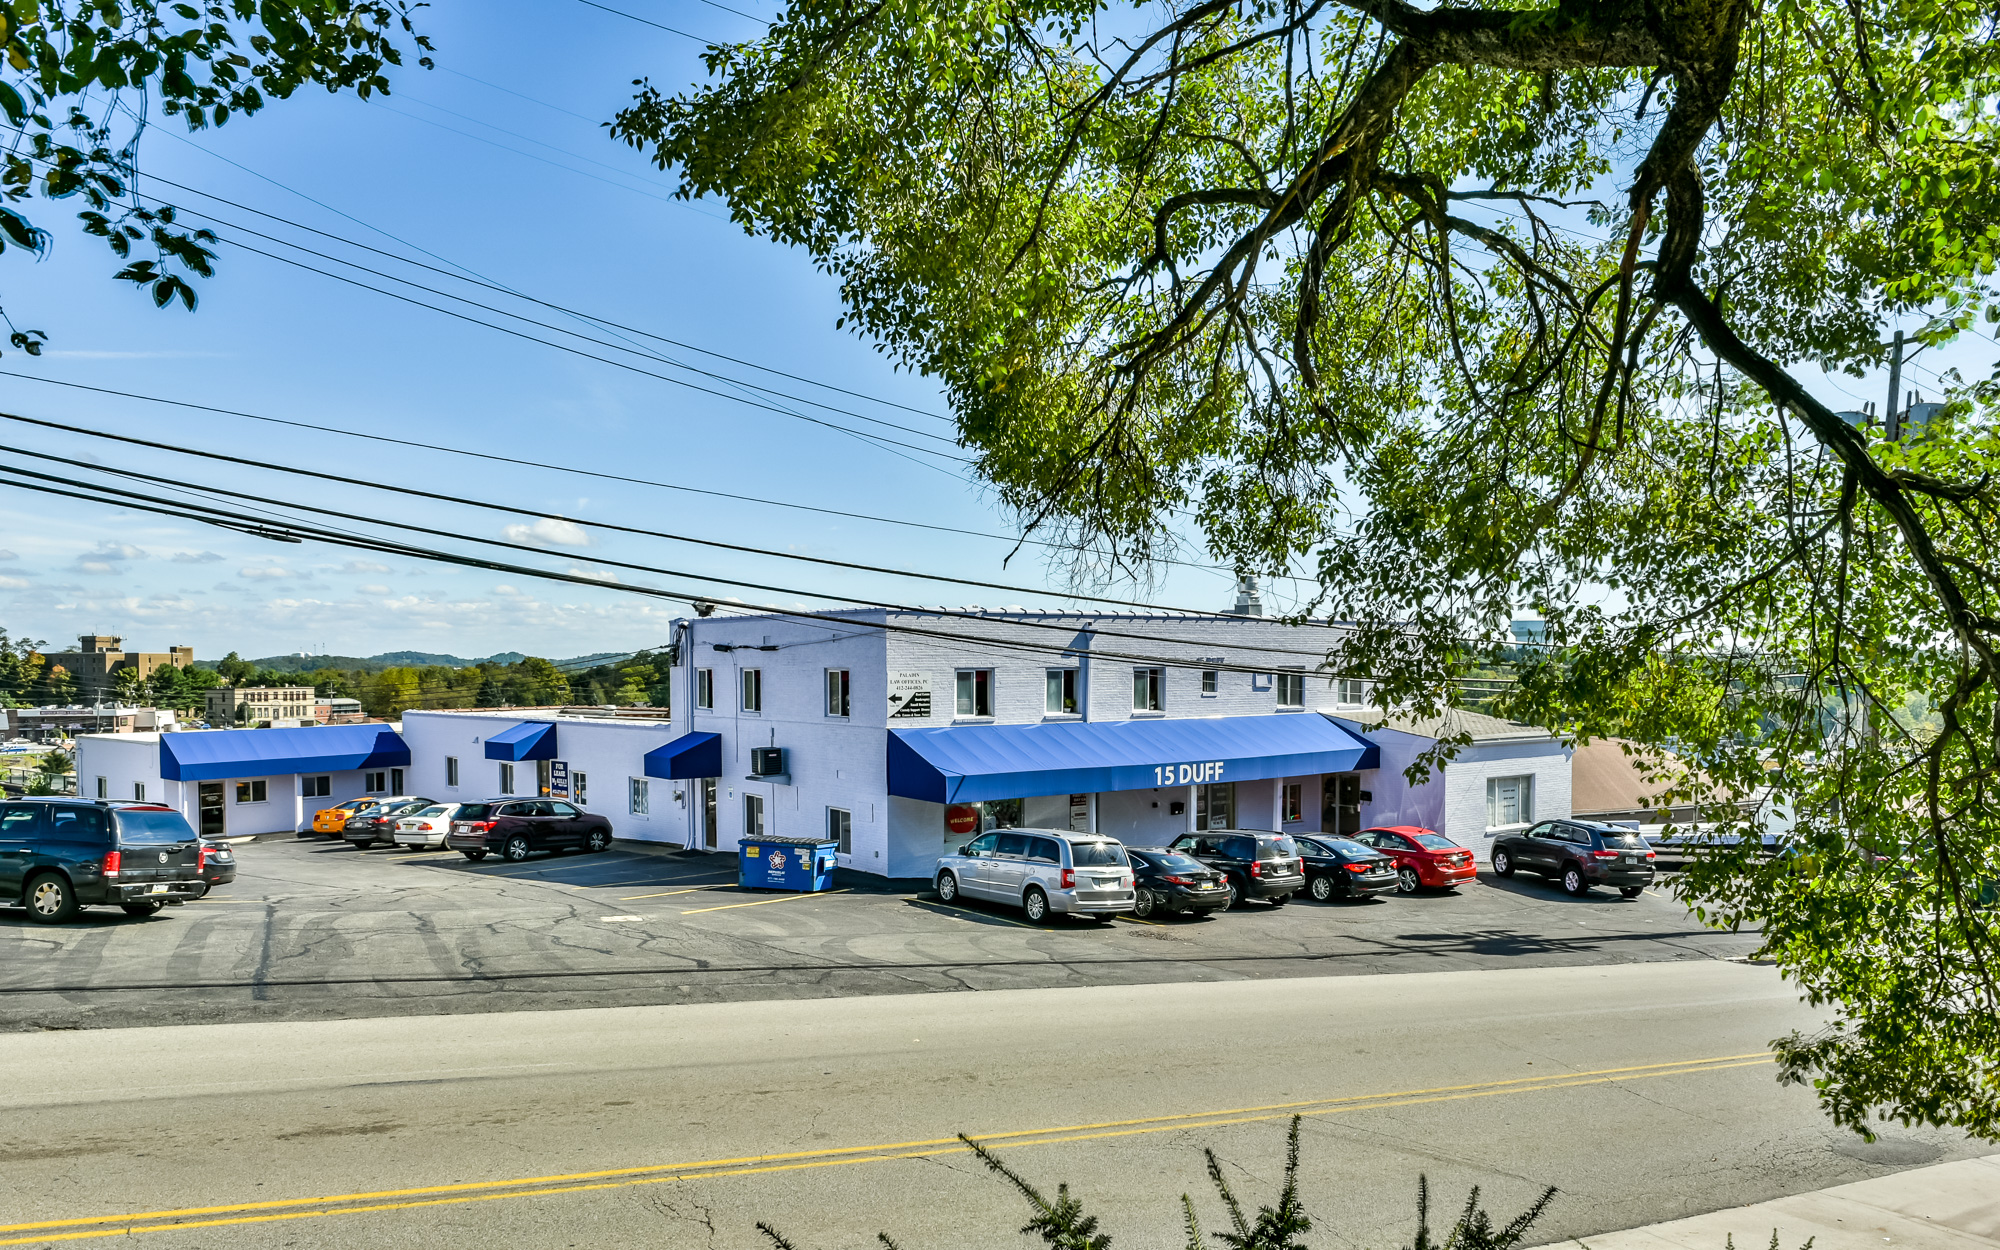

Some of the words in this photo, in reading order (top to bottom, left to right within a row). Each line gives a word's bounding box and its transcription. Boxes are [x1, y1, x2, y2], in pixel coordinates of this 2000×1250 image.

[1154, 766, 1175, 785] 15
[1180, 762, 1224, 784] DUFF
[950, 816, 974, 824] WELCOME
